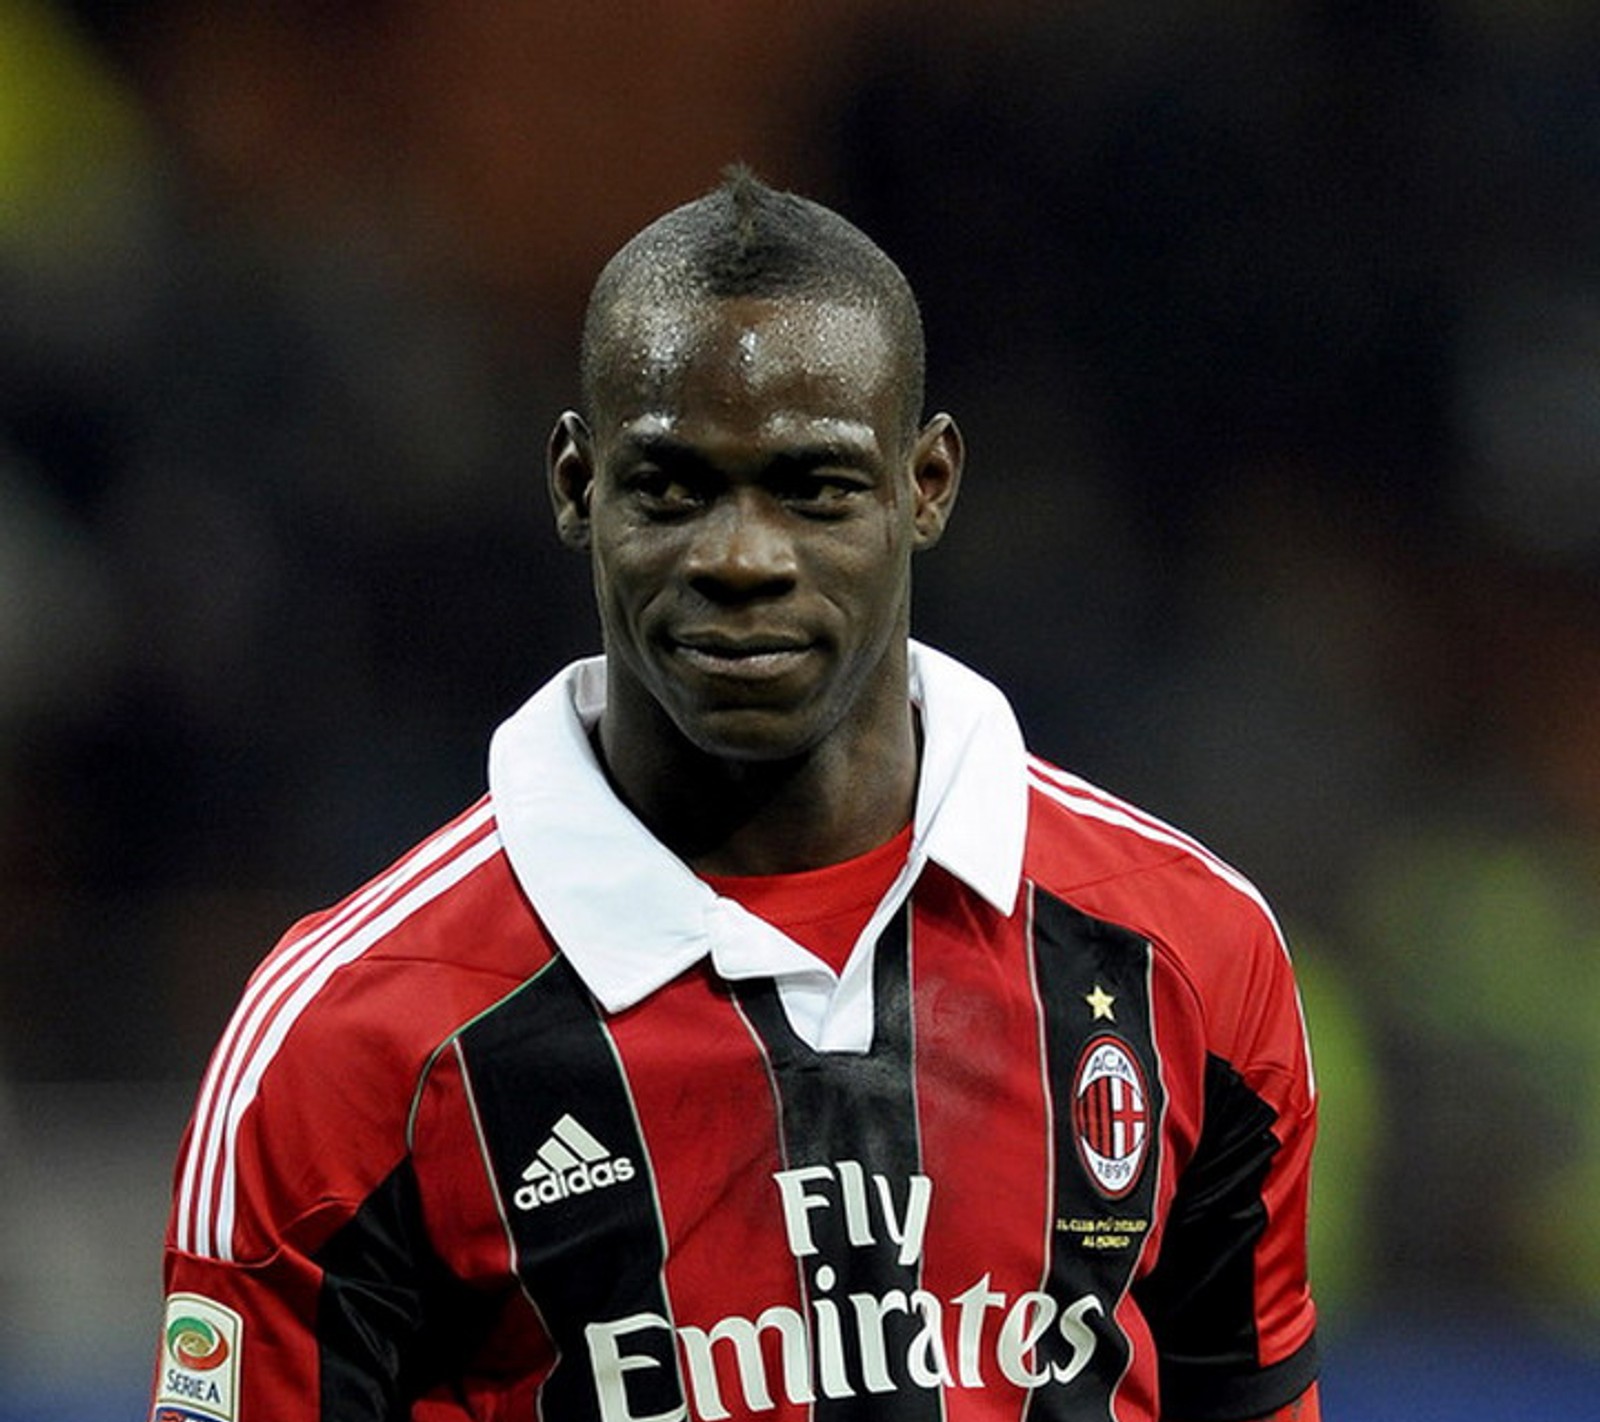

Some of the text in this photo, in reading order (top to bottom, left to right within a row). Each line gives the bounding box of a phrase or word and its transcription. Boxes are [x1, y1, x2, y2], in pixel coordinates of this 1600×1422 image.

[1088, 1049, 1132, 1080] ACM
[514, 1157, 635, 1210] adidas
[1097, 1160, 1130, 1180] 1899
[774, 1160, 932, 1265] Fly
[166, 1368, 222, 1404] SERIE A
